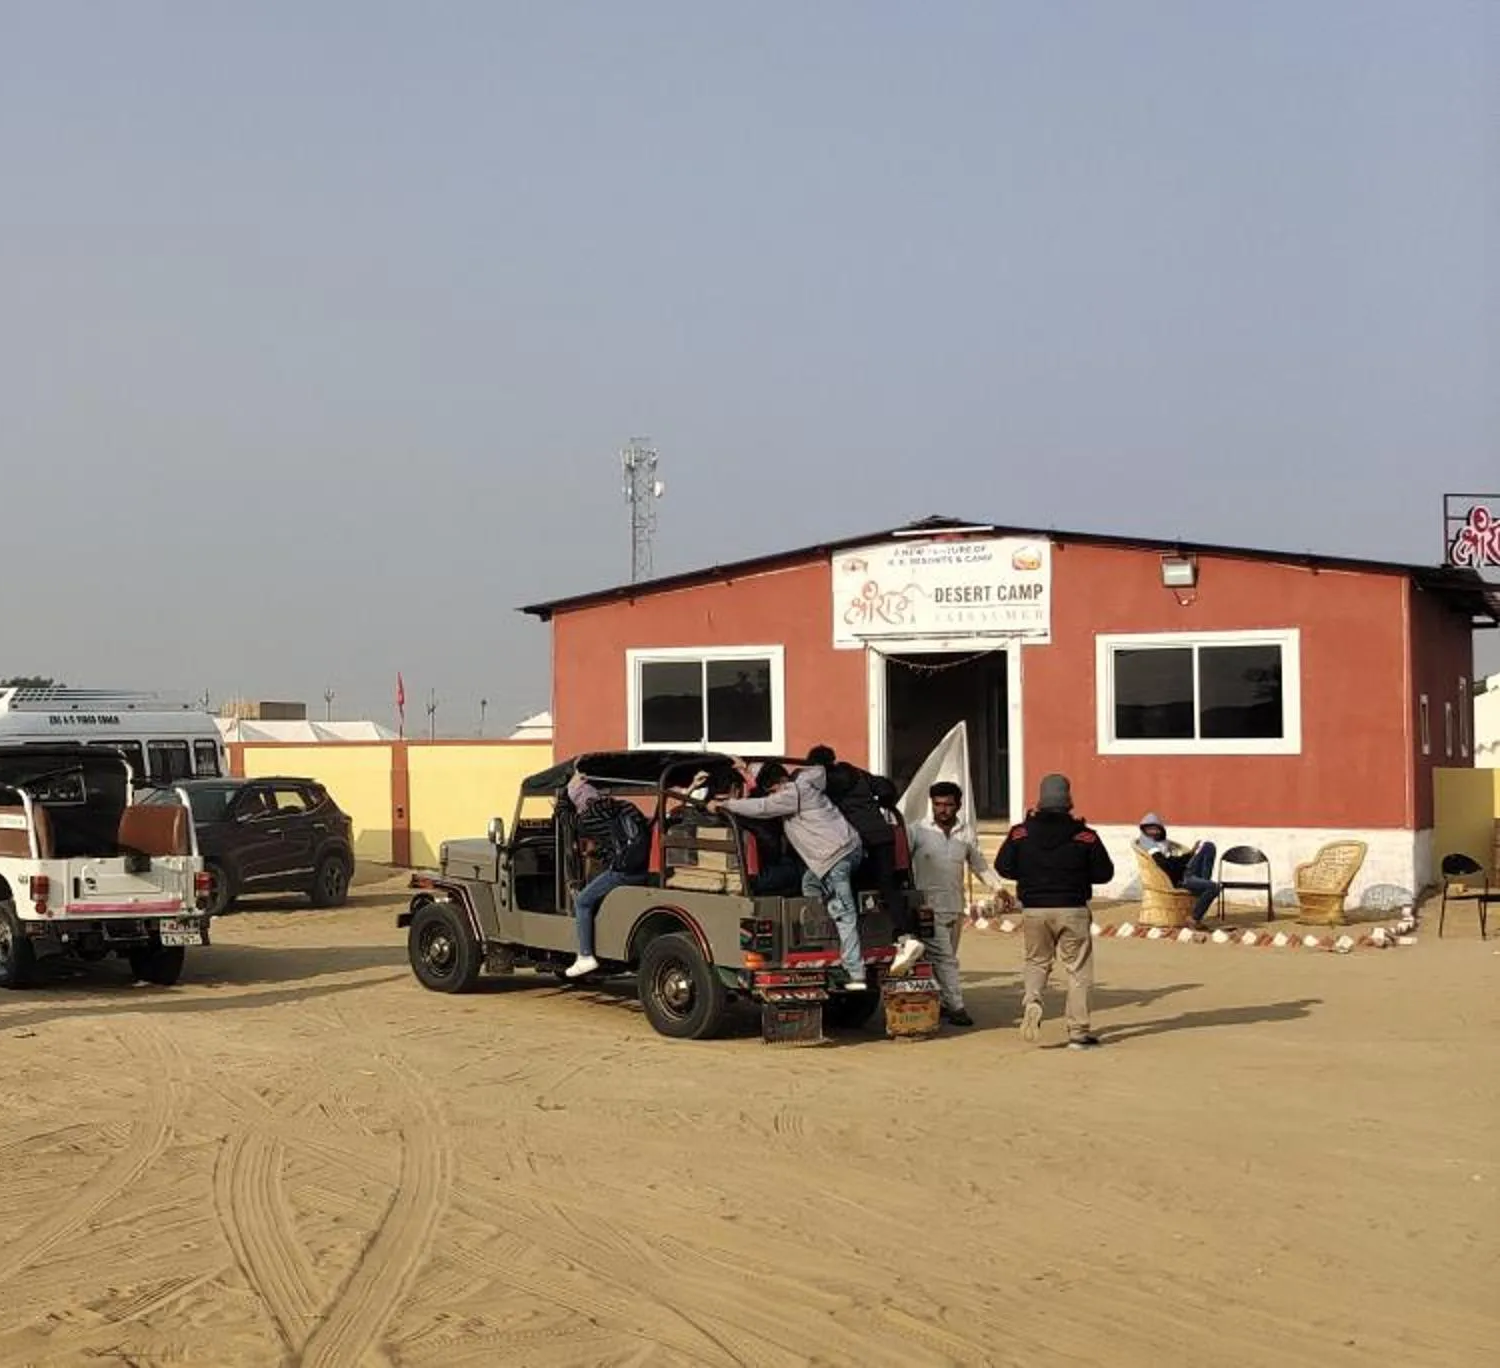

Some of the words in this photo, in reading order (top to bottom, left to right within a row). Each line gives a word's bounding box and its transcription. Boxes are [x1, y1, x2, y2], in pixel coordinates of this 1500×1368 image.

[934, 585, 992, 603] DESERT
[997, 583, 1044, 602] CAMP
[934, 609, 1044, 622] AIAMER
